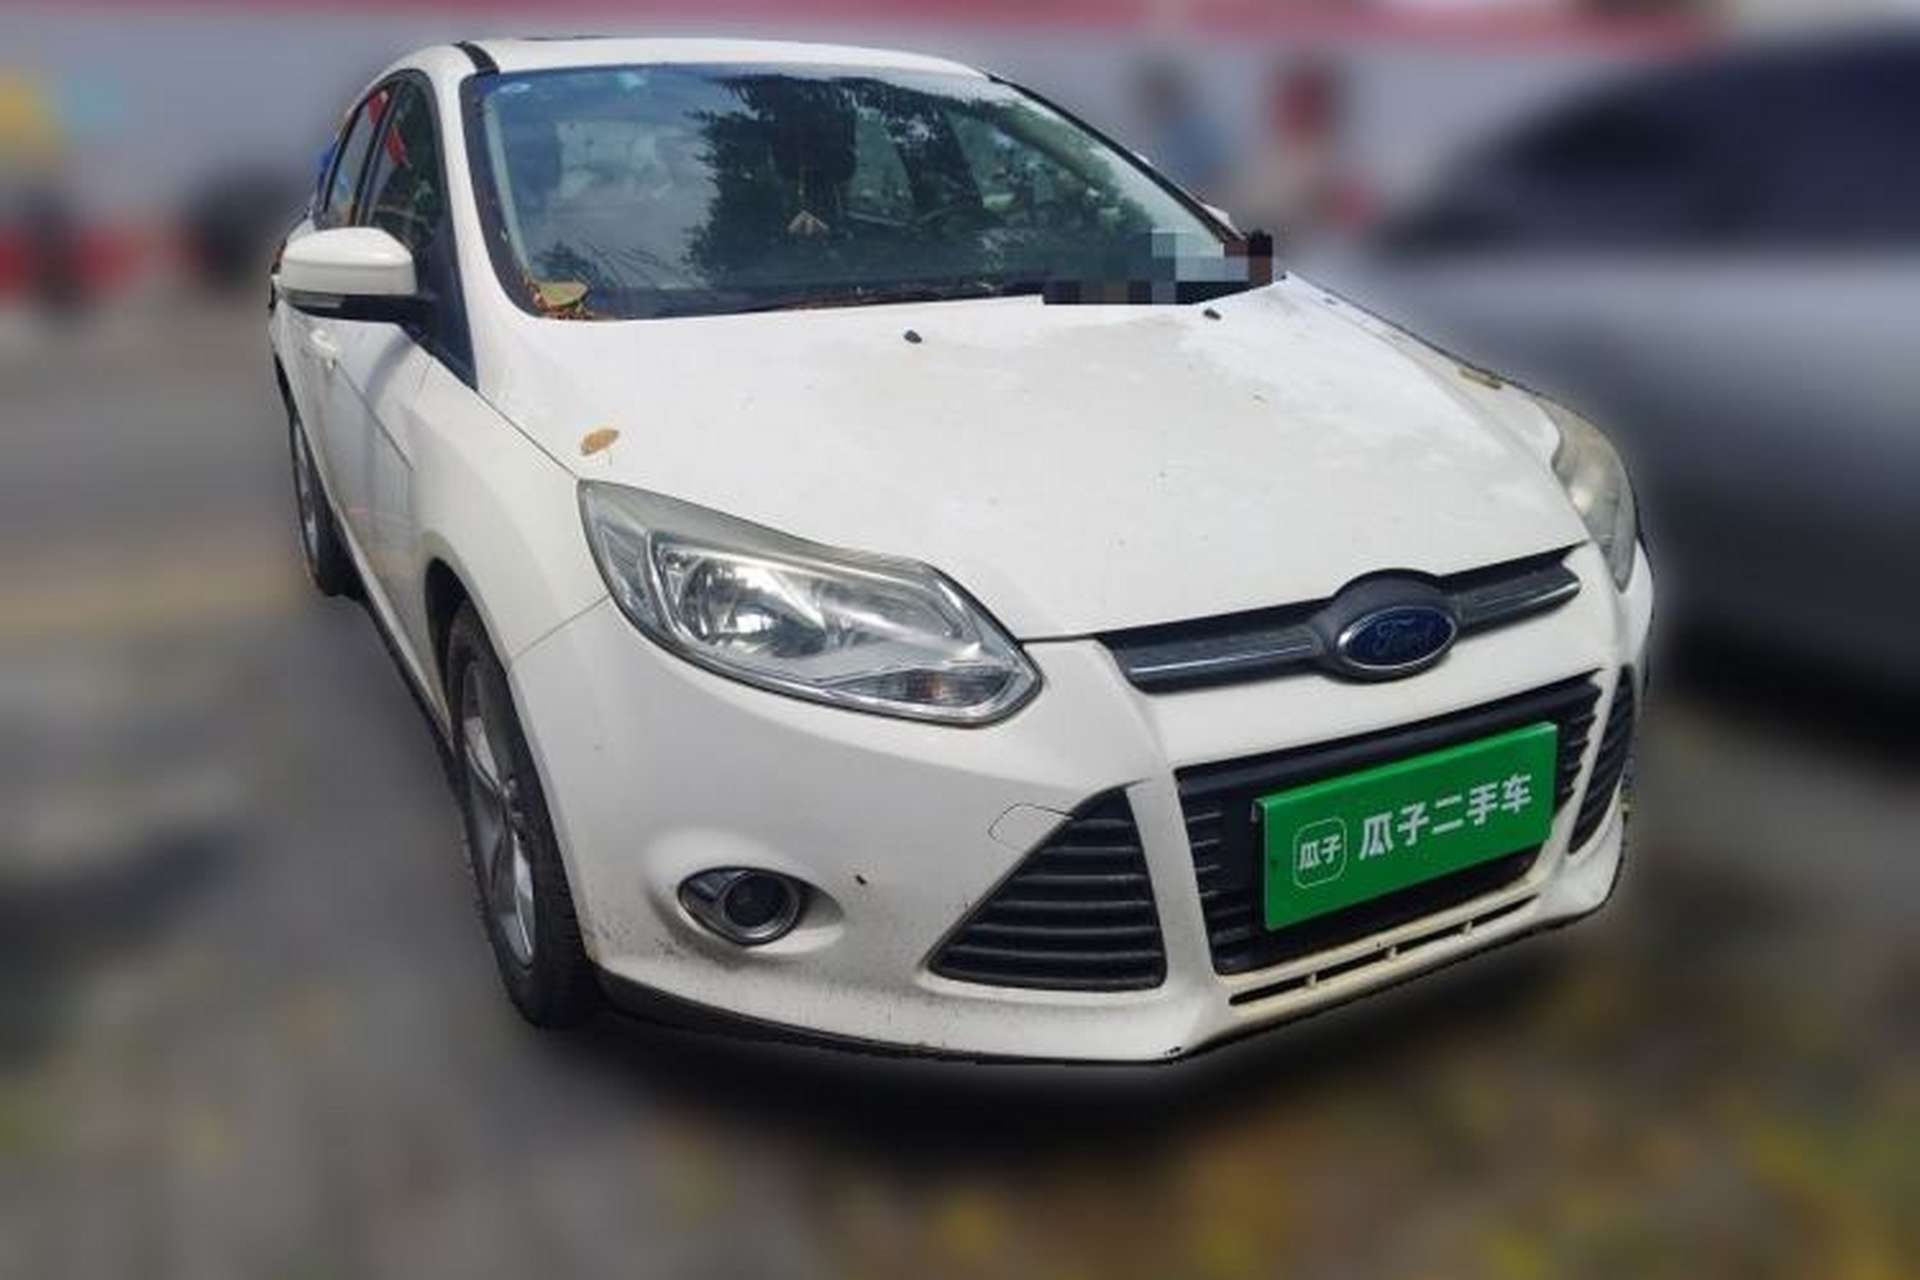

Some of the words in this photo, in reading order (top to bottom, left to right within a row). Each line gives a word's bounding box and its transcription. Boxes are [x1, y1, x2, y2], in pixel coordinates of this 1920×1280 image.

[1369, 616, 1437, 657] Fd
[1359, 774, 1533, 860] 瓜子二手车
[1299, 834, 1342, 870] 瓜子
